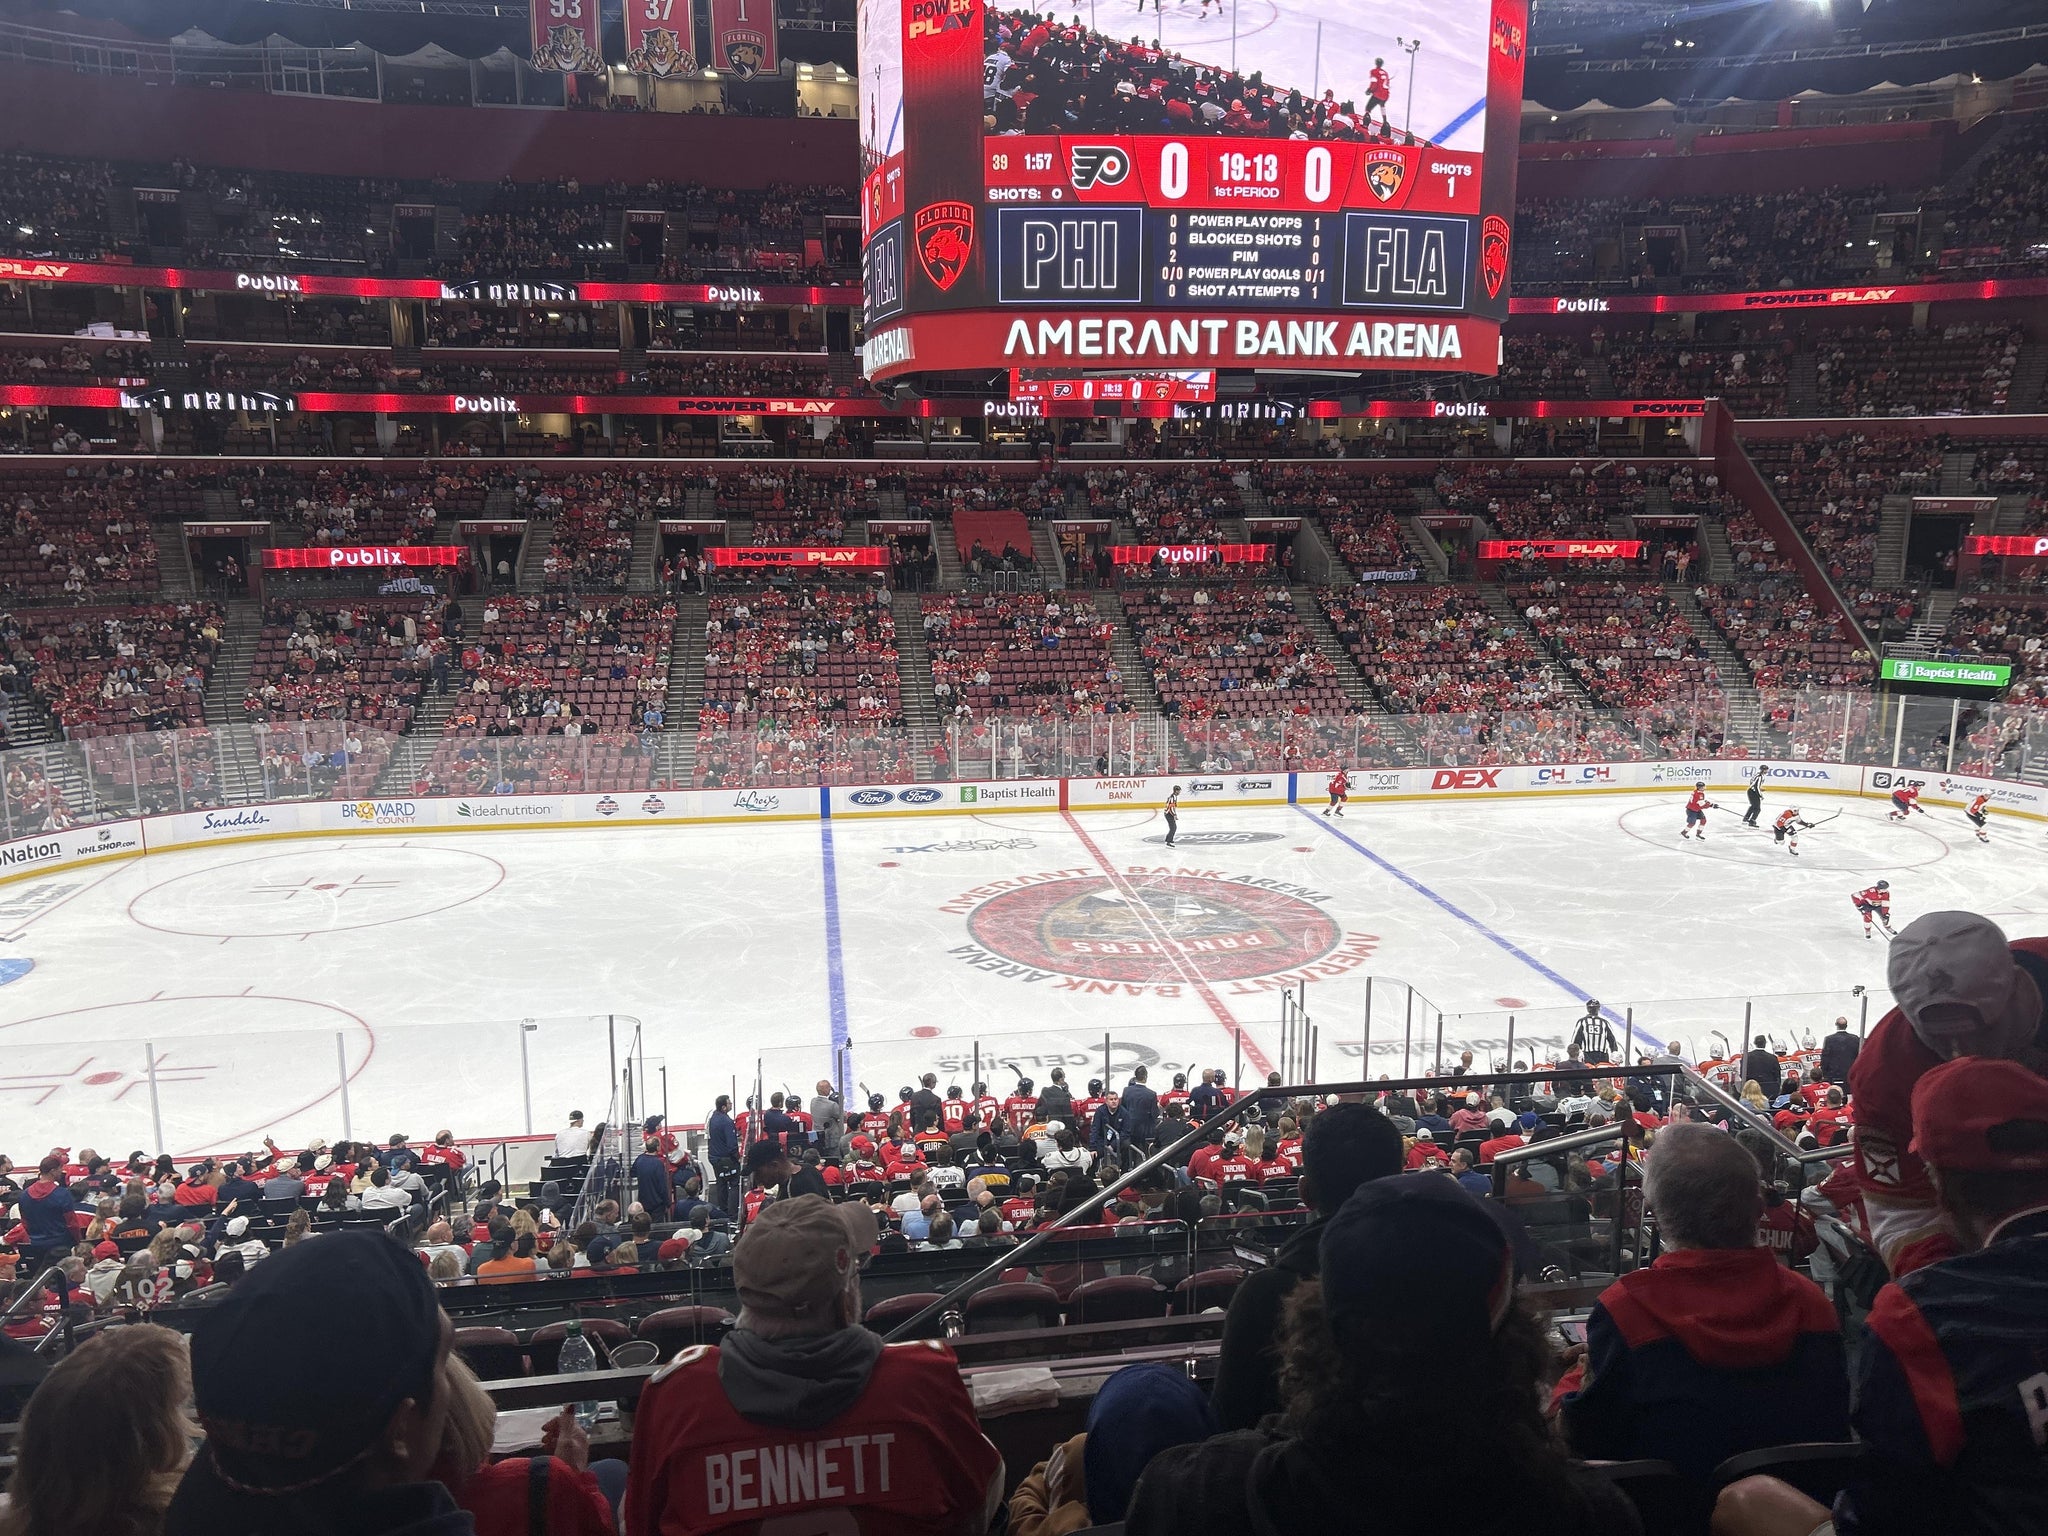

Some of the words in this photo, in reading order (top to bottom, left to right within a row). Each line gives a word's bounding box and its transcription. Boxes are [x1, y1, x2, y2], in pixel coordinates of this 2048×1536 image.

[644, 0, 672, 21] 37
[913, 0, 972, 21] POWER
[909, 10, 975, 40] PLAY
[1496, 15, 1521, 46] POWER
[1492, 31, 1522, 62] PLAY
[992, 154, 1008, 171] 39
[1024, 153, 1053, 171] 1:57
[1368, 152, 1402, 163] FLORIDA
[1160, 142, 1188, 200] 0
[1219, 152, 1278, 182] 19:13
[1304, 146, 1332, 203] 0
[1431, 163, 1472, 177] SHOTS
[988, 189, 1042, 201] SHOTS:
[1051, 188, 1063, 200] 0
[1214, 186, 1232, 197] 1st
[1234, 186, 1280, 199] PERIOD
[1447, 176, 1455, 198] 1
[919, 205, 969, 226] FLORIDA
[1170, 214, 1177, 228] 0
[1190, 215, 1233, 228] POWER
[1235, 216, 1268, 228] PLAY
[1269, 216, 1303, 229] OPPS
[1314, 217, 1320, 231] 1
[1170, 232, 1177, 245] 0
[1189, 233, 1253, 245] BLOCKED
[1255, 234, 1302, 246] SHOTS
[1312, 234, 1320, 248] 0
[1023, 220, 1118, 289] PHI
[1169, 249, 1177, 263] 2
[1232, 251, 1259, 262] PIM
[1312, 252, 1319, 265] 0
[1365, 226, 1447, 296] FLA
[1162, 266, 1183, 280] 0/0
[1188, 267, 1229, 279] POWER
[1230, 268, 1260, 280] PLAY
[1262, 268, 1301, 280] GOALS
[1305, 268, 1325, 283] 0/1
[1169, 284, 1176, 298] 0
[1188, 285, 1225, 297] SHOT
[1227, 285, 1300, 297] ATTEMPTS
[1312, 286, 1318, 300] 1
[1745, 294, 1829, 306] POWER
[1830, 289, 1896, 303] PLAY
[1003, 319, 1229, 356] AMERANT
[1235, 320, 1340, 356] BANK
[1344, 321, 1462, 359] ARENA
[1083, 382, 1093, 399] 0
[1131, 381, 1142, 400] 0
[678, 401, 767, 412] POWER
[769, 401, 837, 413] PLAY
[464, 524, 478, 533] 115
[511, 523, 525, 533] 116
[664, 525, 677, 533] 116
[709, 524, 722, 533] 117
[871, 525, 884, 533] 117
[914, 525, 928, 533] 118
[1096, 523, 1109, 532] 119
[1285, 520, 1299, 529] 120
[1458, 519, 1471, 527] 121
[737, 552, 805, 562] POWER
[807, 551, 859, 562] PLAY
[1568, 544, 1618, 555] PLAY
[1914, 666, 1955, 680] Baptist
[1957, 668, 1997, 682] Health
[1431, 769, 1503, 790] DEX
[1666, 766, 1712, 777] BioStem
[1095, 779, 1147, 790] AMERANT
[857, 790, 892, 804] Ford
[906, 789, 940, 803] Ford
[980, 787, 1020, 801] Baptist
[1022, 786, 1056, 798] Health
[1108, 791, 1134, 800] BANK
[2008, 791, 2038, 802] FLORIDA
[342, 802, 416, 819] BROWARD
[472, 804, 551, 817] idealnutrition
[203, 810, 270, 829] Sandals
[376, 816, 416, 825] COUNTY
[938, 867, 1093, 915] AMERANT
[1127, 866, 1232, 880] BANK
[1230, 873, 1334, 905] ARENA
[944, 1105, 964, 1121] 10
[1015, 1111, 1034, 1132] 12
[1758, 1228, 1794, 1249] CHUK
[120, 1277, 176, 1301] 102
[706, 1433, 896, 1516] BENNETT
